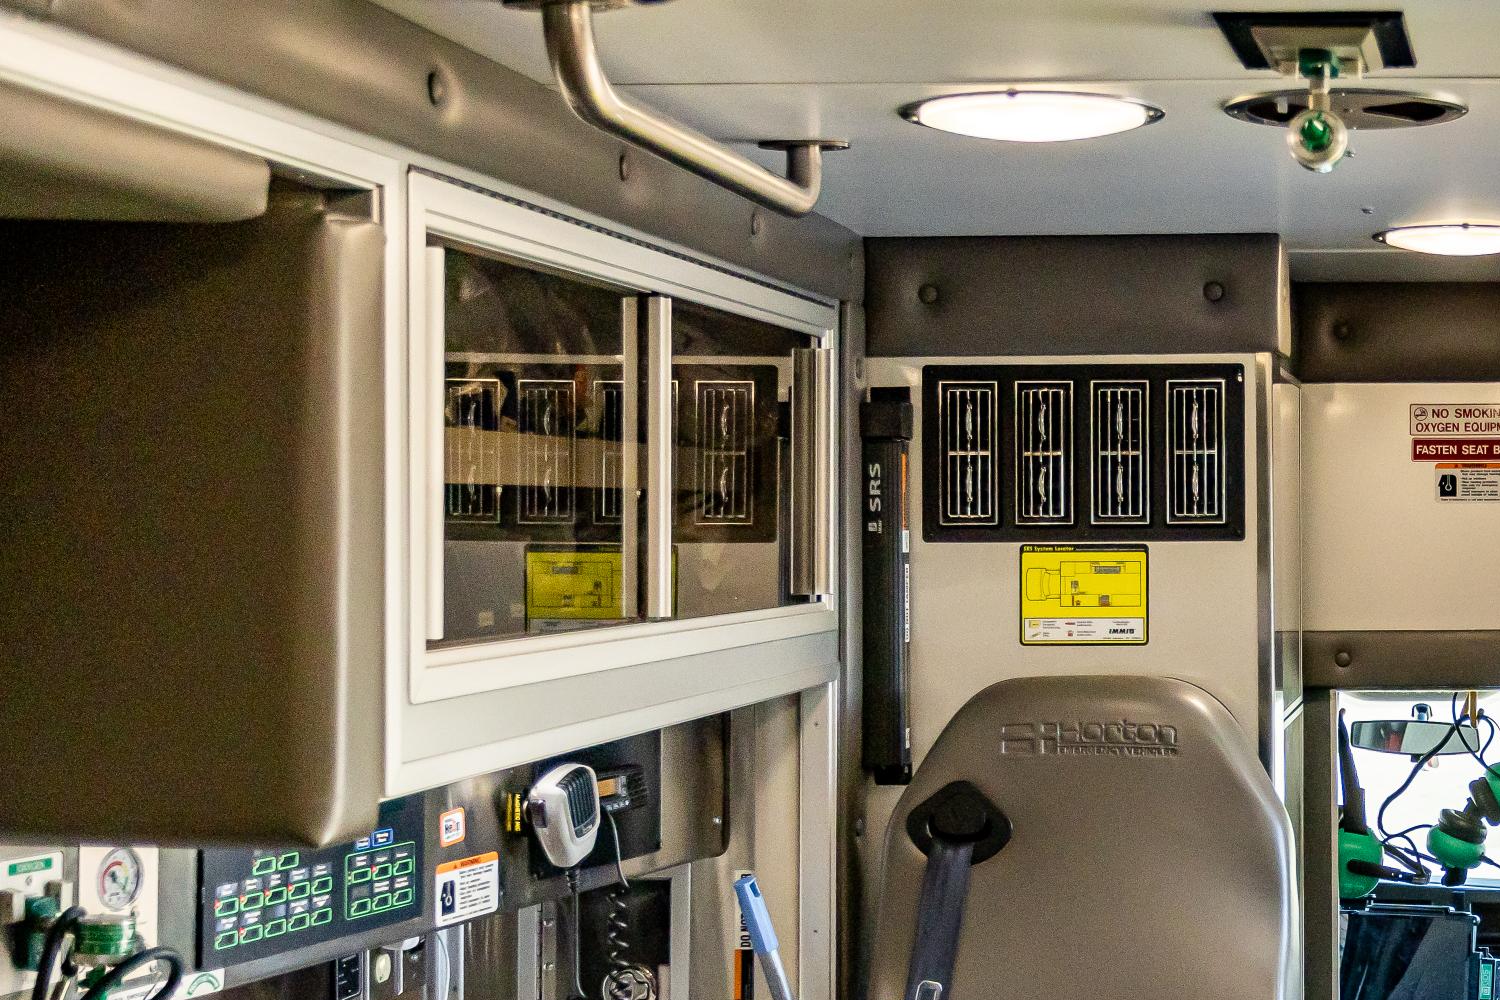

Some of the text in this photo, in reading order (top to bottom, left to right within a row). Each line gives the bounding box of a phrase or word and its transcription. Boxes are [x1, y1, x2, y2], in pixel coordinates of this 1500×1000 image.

[1431, 408, 1449, 419] NO
[1415, 422, 1460, 433] OXYGEN
[1416, 445, 1458, 455] FASTEN
[1461, 445, 1490, 455] SEAT
[869, 463, 881, 512] SRS
[740, 934, 752, 948] DO
